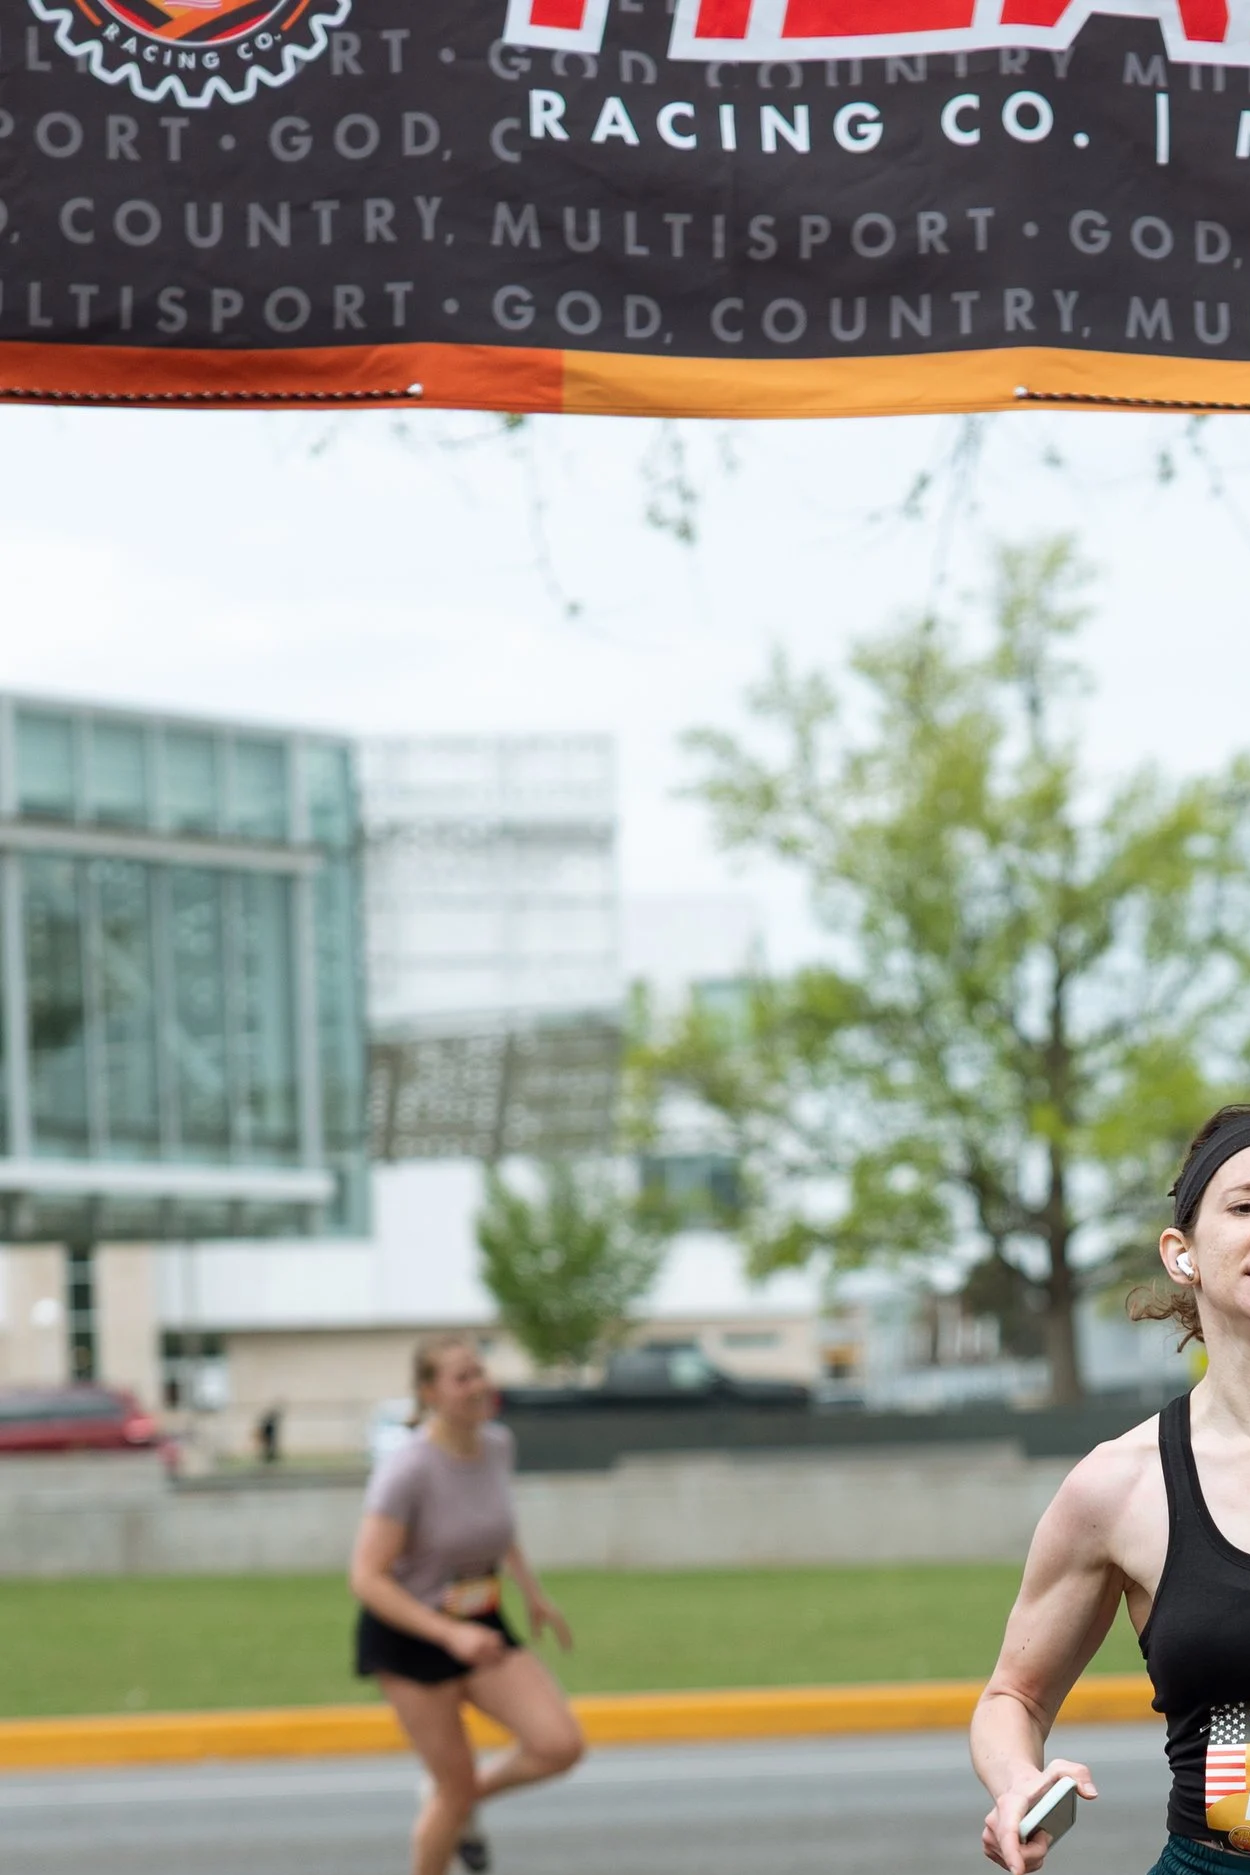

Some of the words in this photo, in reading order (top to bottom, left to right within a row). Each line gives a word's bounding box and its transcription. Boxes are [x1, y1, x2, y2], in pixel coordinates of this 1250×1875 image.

[101, 22, 220, 70] RACING
[269, 112, 454, 163] GOD,
[528, 88, 884, 155] RACING
[940, 89, 1090, 149] CO.
[58, 195, 455, 247] COUNTRY,
[490, 202, 995, 261] MULTISPORT
[1069, 208, 1242, 270] GOD,
[0, 280, 414, 333] LTISPORT
[491, 284, 673, 344] GOD,
[710, 287, 1091, 343] COUNTRY,
